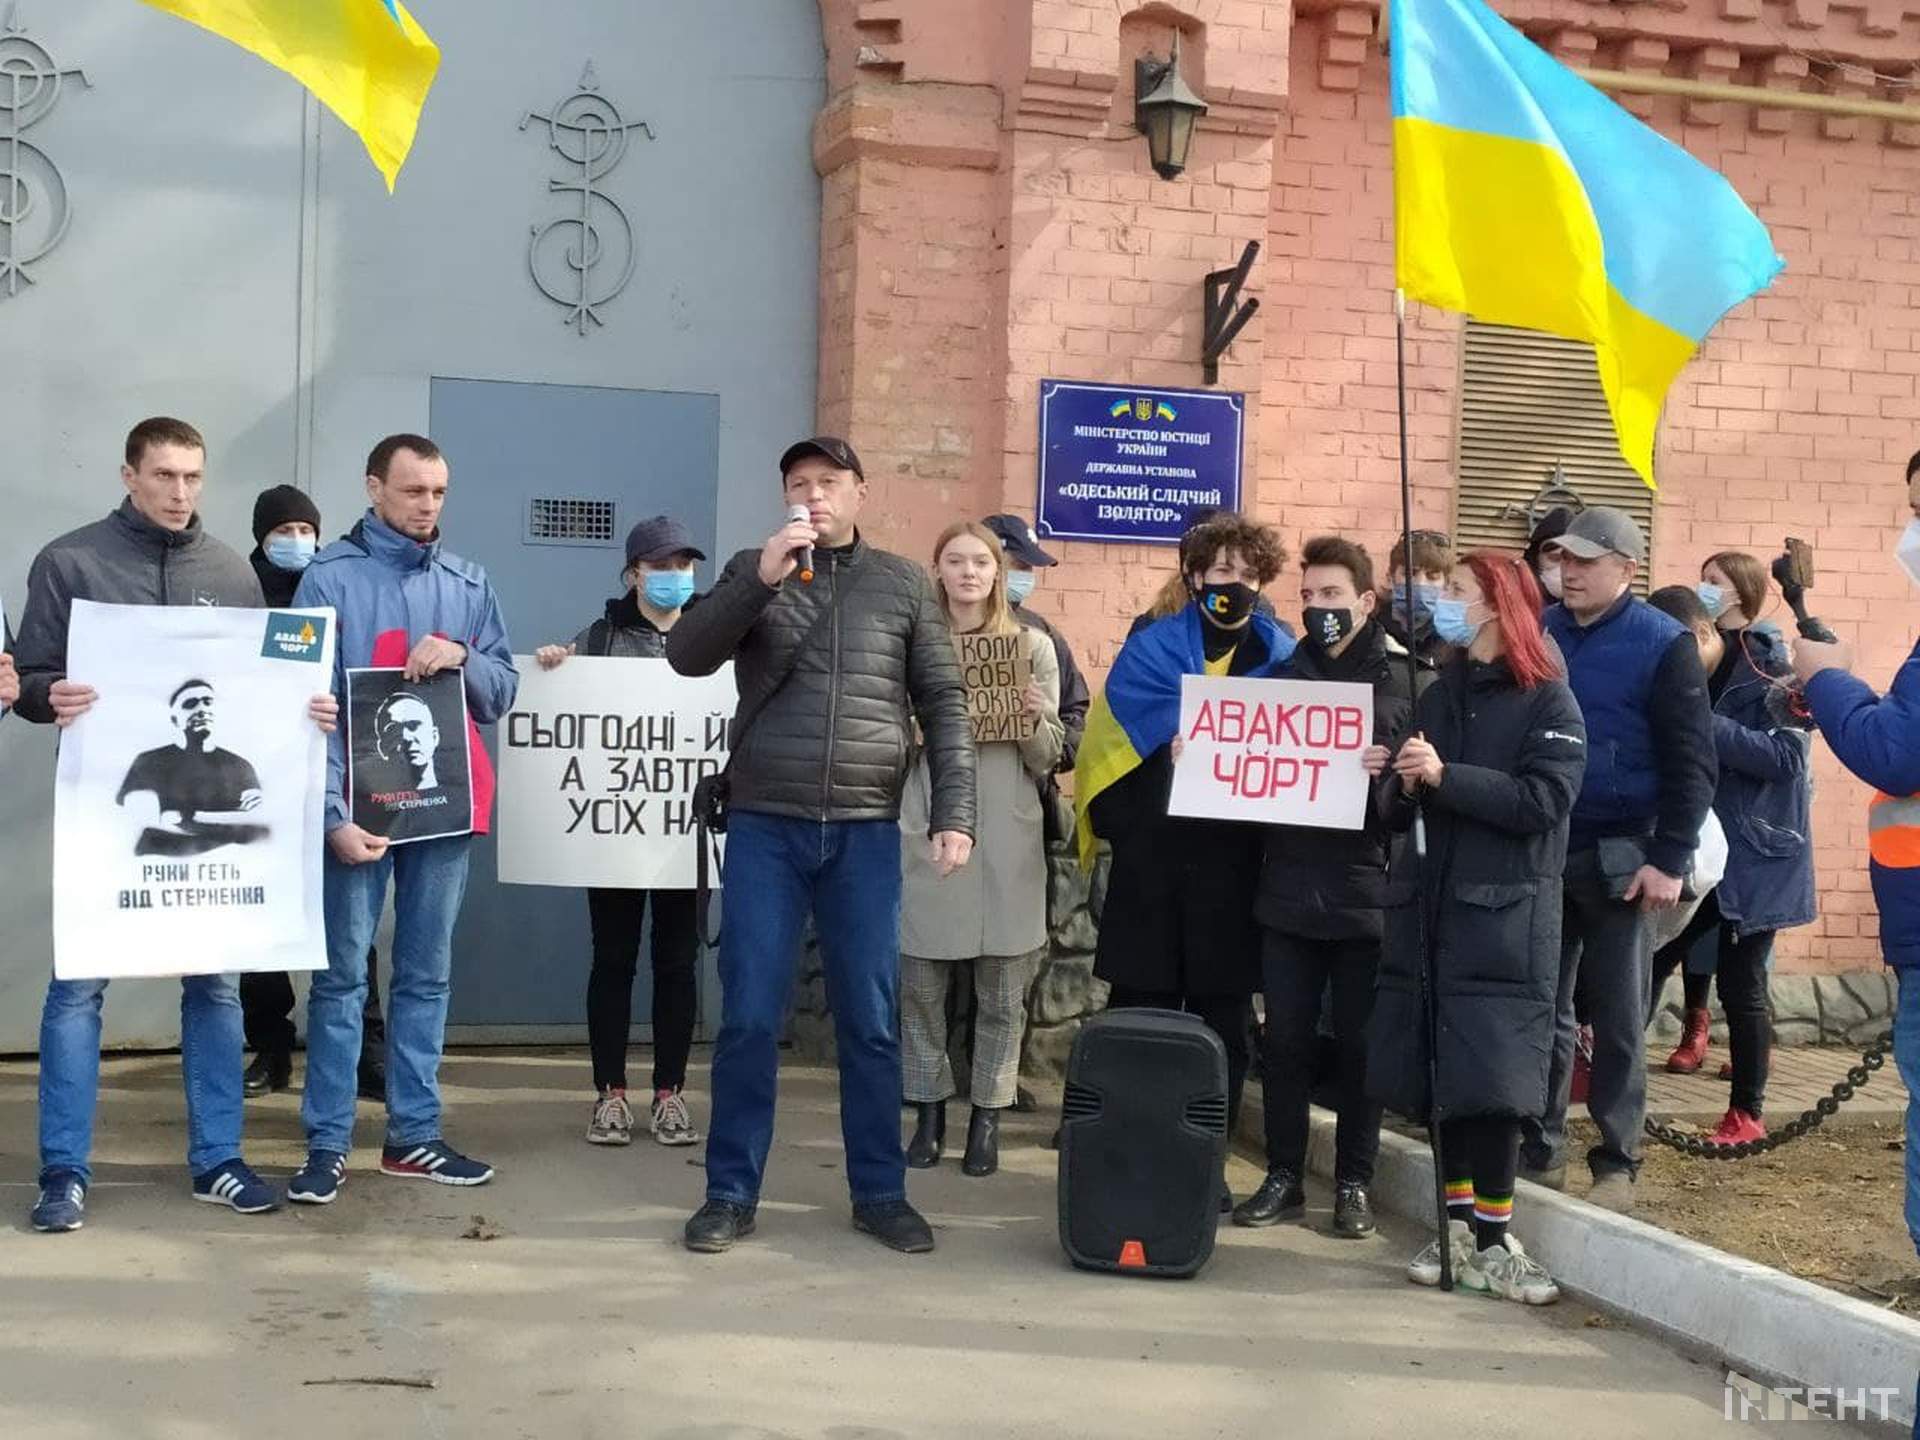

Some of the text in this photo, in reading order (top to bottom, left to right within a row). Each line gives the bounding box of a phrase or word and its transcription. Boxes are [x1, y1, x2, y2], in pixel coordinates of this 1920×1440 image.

[1074, 425, 1211, 446] МІНІСТЕРСТВО ЮСТИЦІЇ
[1117, 443, 1167, 457] УКРАЇНИ
[1086, 461, 1197, 479] ДЕРЖАВНА УСТАНОВА
[1058, 482, 1221, 505] «ОДЕСЬКИЙ СЛІДЧИЙ
[1098, 504, 1182, 522] ІЗОЛЯТОР»
[964, 661, 1016, 689] СОБІ
[508, 711, 675, 754] СЬОГОДНІ
[1189, 699, 1363, 750] АВАКОВ
[559, 756, 585, 791] А
[1213, 752, 1329, 801] ЧОРТ
[565, 793, 647, 835] УСІХ
[143, 863, 240, 882] РУКИ ГЕТЬ
[119, 886, 265, 909] ВІД СТЕРНЕНКА
